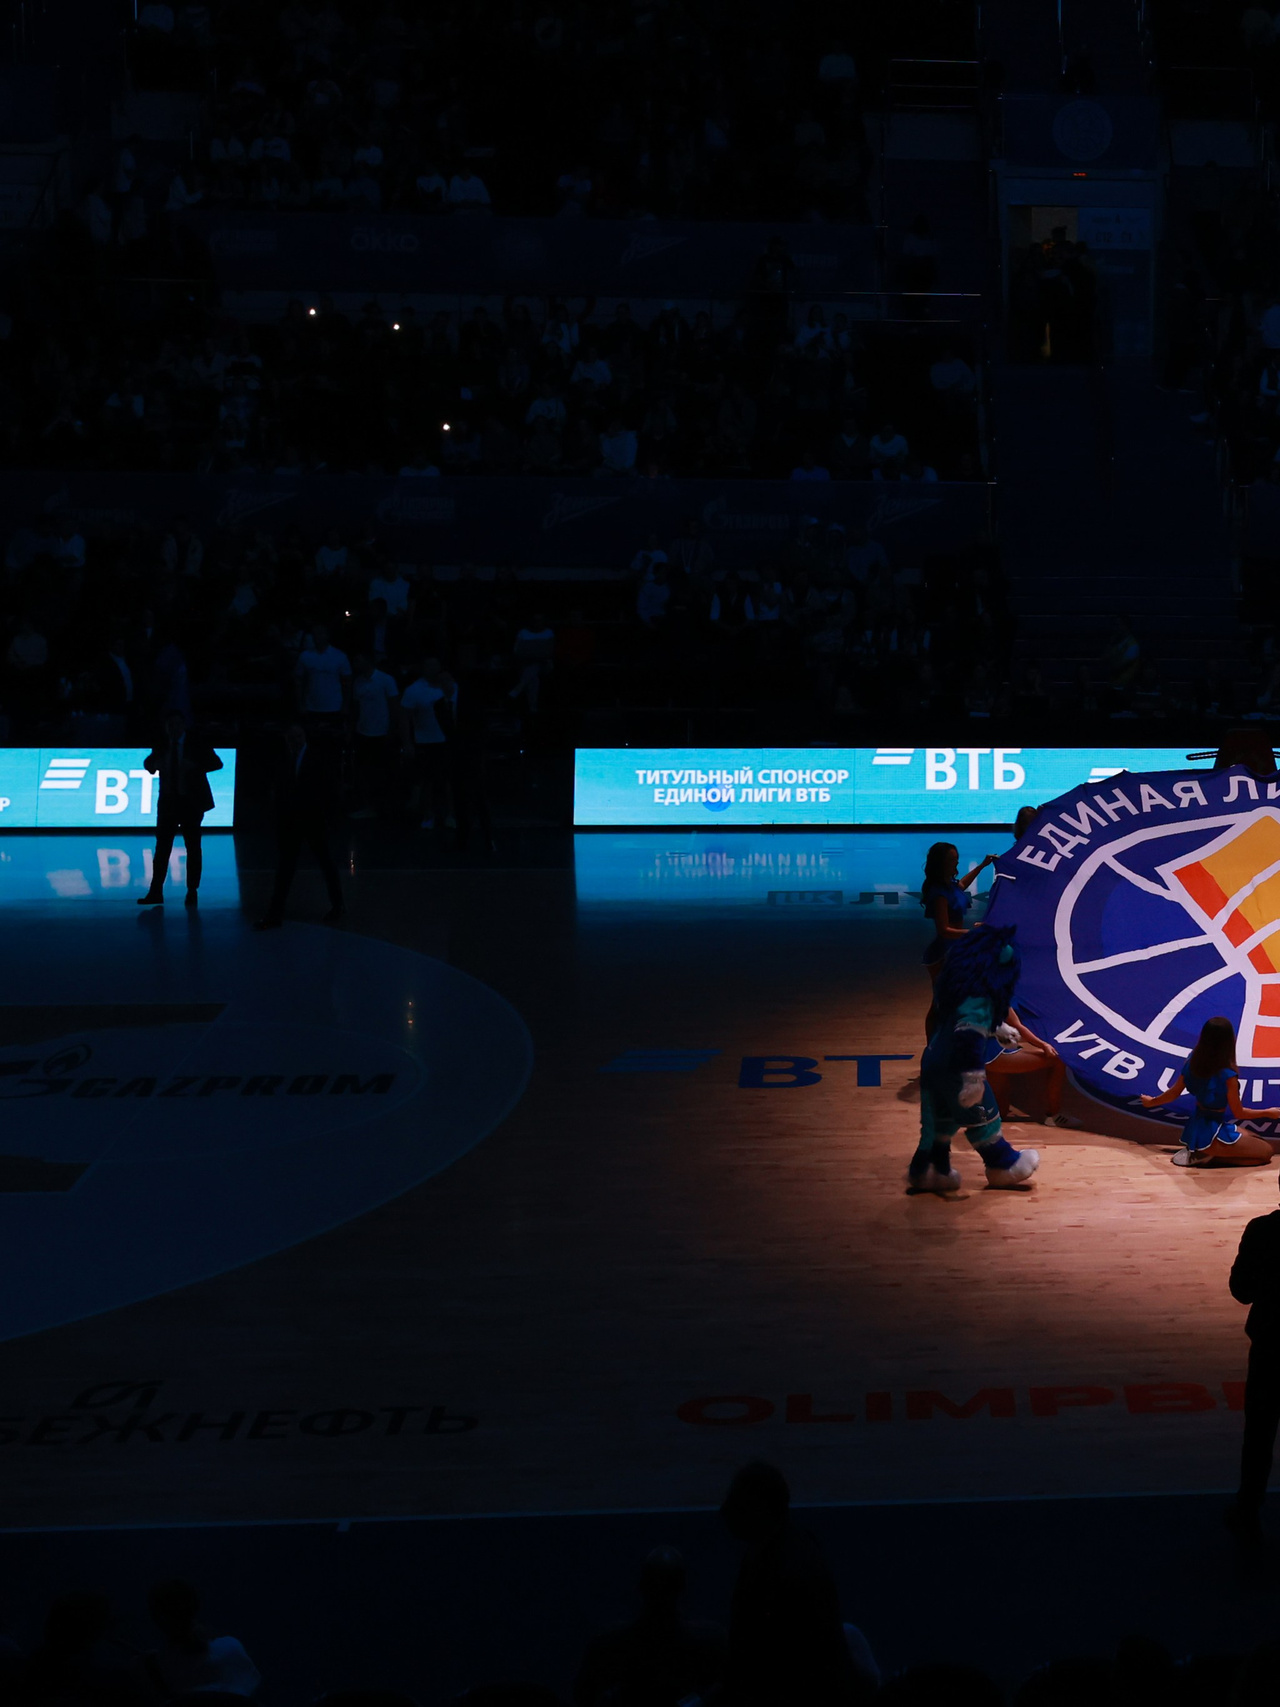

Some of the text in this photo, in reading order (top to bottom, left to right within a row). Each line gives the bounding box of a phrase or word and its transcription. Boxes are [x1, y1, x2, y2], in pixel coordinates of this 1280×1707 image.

[636, 766, 849, 785] ТИТУЛЬНЫЙ СПОНСОР
[925, 748, 1026, 791] ВТБ
[95, 769, 161, 815] ВТ
[654, 785, 831, 806] ЕДИНОЙ ЛИГИ ВТБ
[1016, 779, 1214, 873] ЕДИНАЯ
[1053, 1018, 1147, 1081] VTB
[69, 1073, 397, 1100] GAZPROM
[738, 1054, 915, 1089] ВТ
